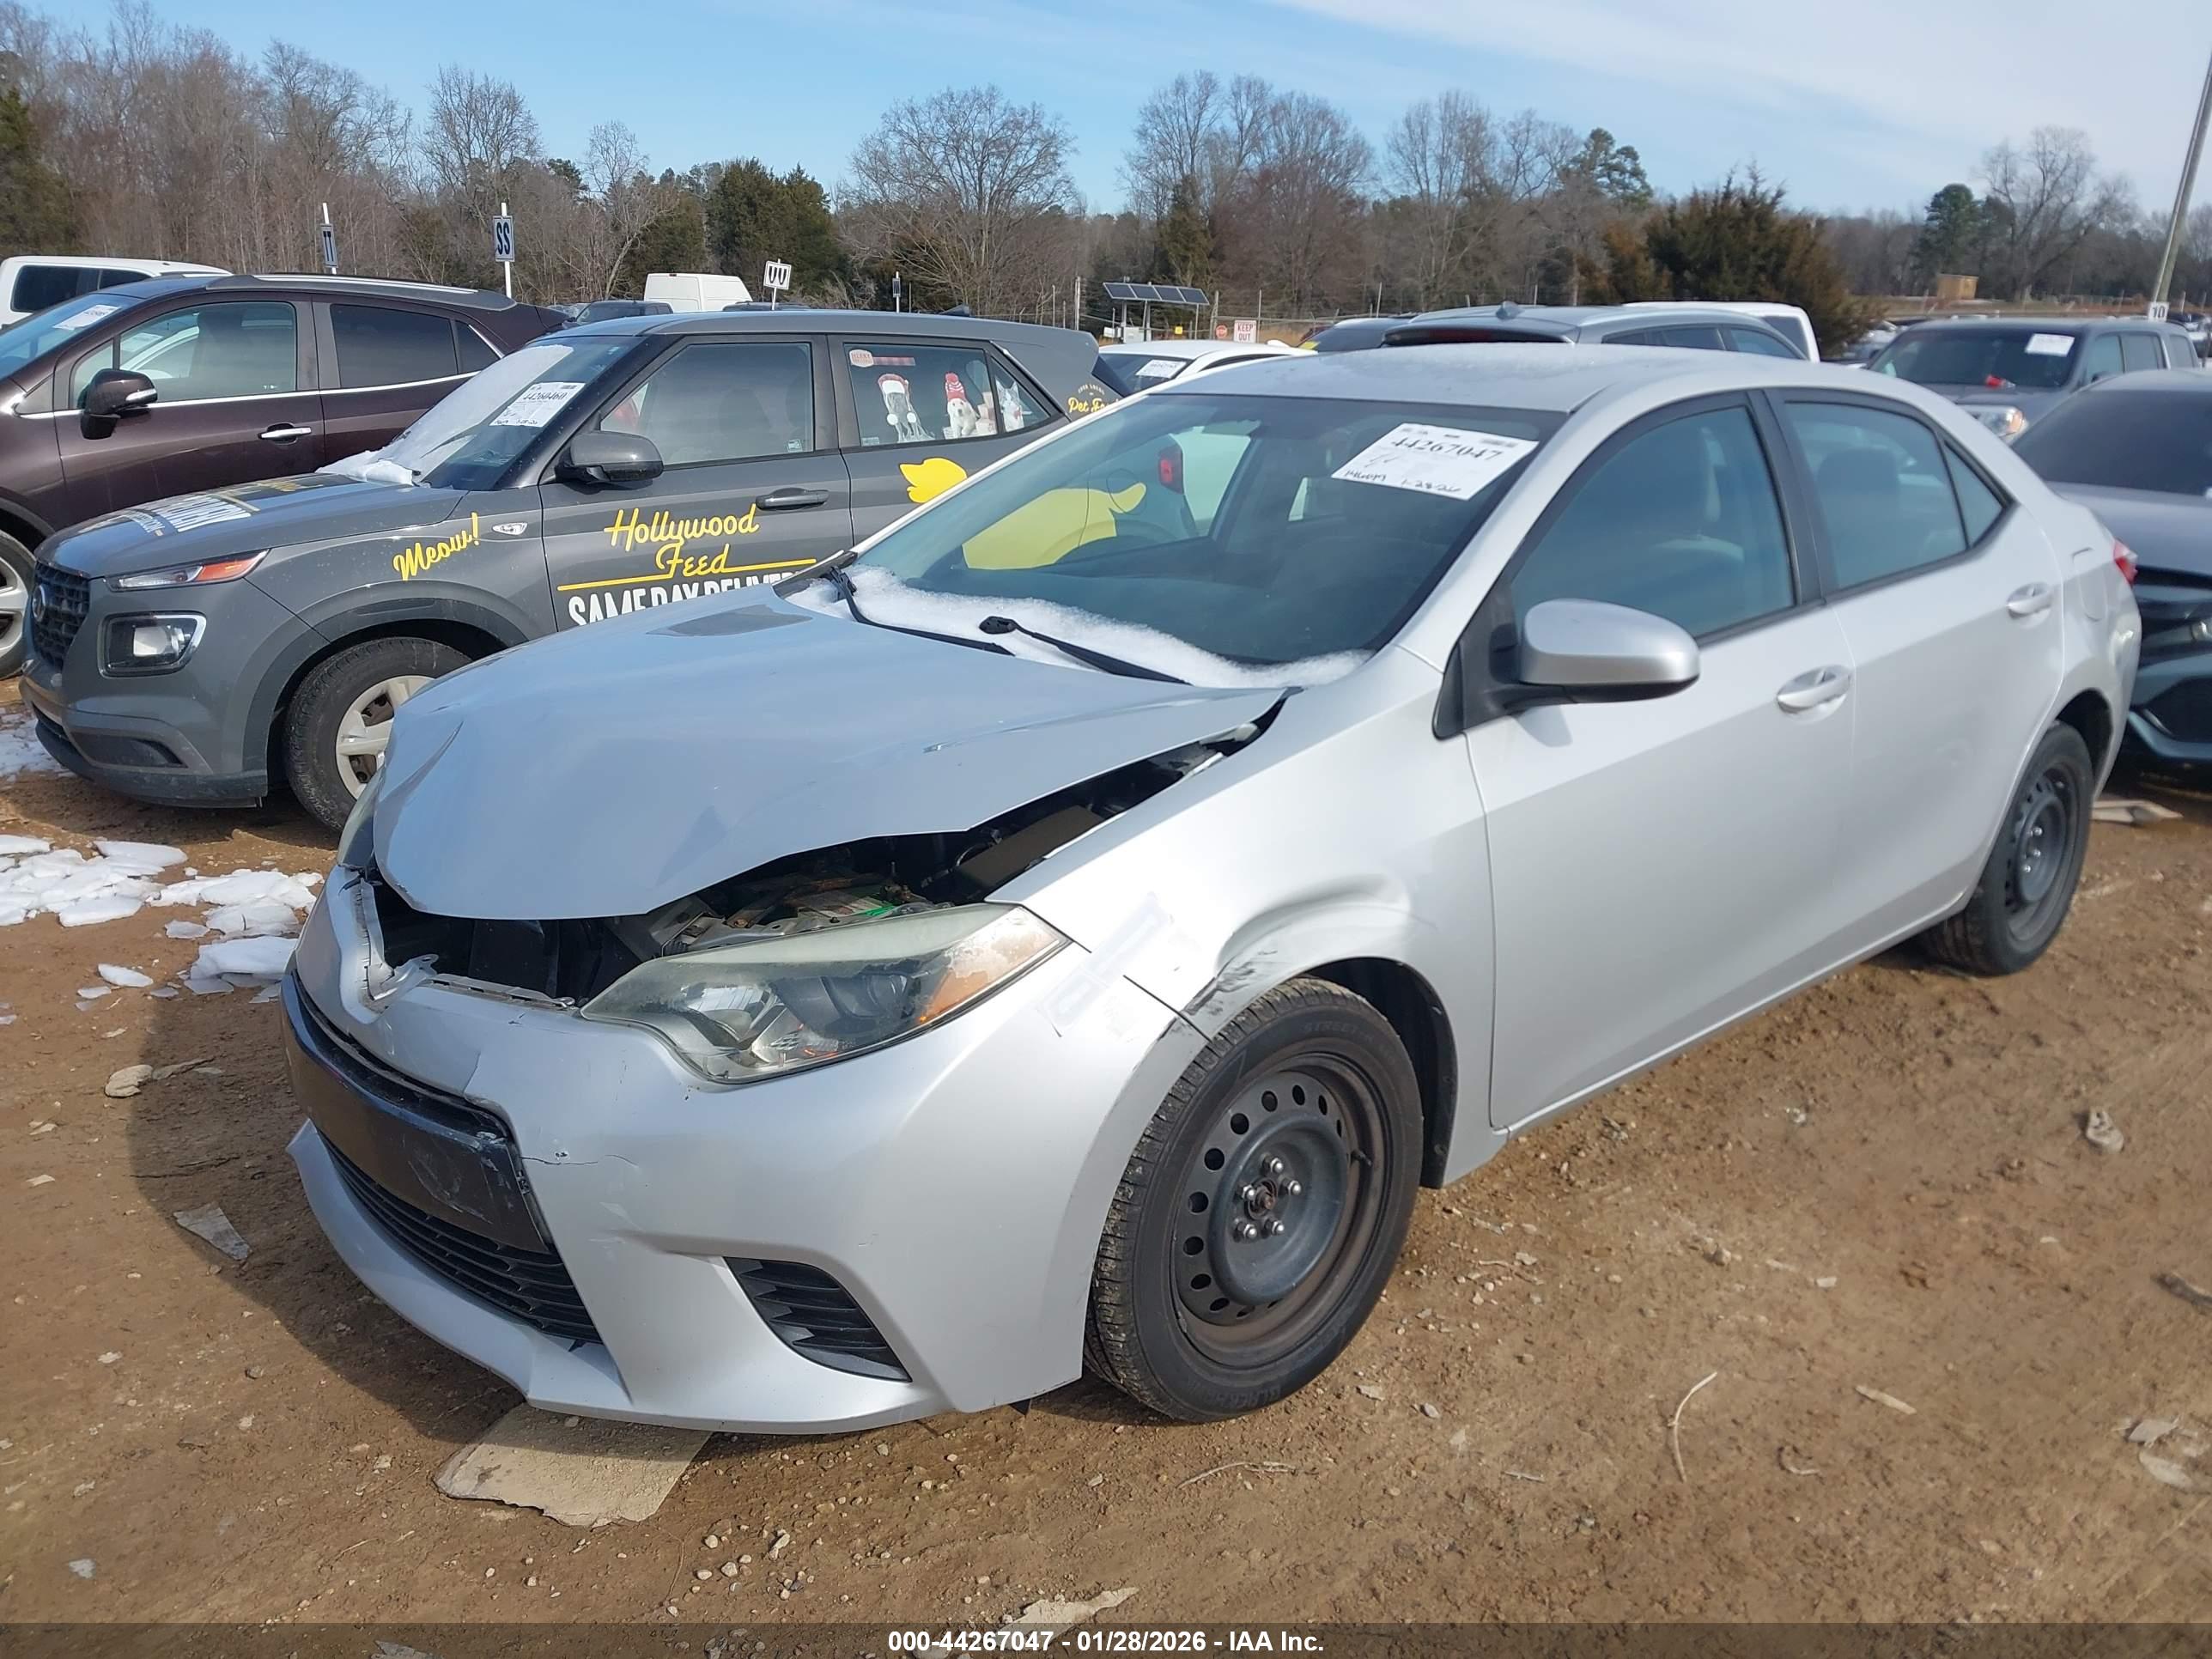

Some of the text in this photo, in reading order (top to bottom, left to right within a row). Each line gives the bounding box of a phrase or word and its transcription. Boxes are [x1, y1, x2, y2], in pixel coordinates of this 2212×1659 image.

[496, 222, 511, 255] SS
[1237, 322, 1254, 332] KEEP
[1238, 332, 1251, 341] OUT
[1067, 397, 1089, 413] Pet
[1390, 436, 1505, 461] 44267047
[604, 503, 760, 552] Hollywood
[392, 511, 480, 581] Meow!
